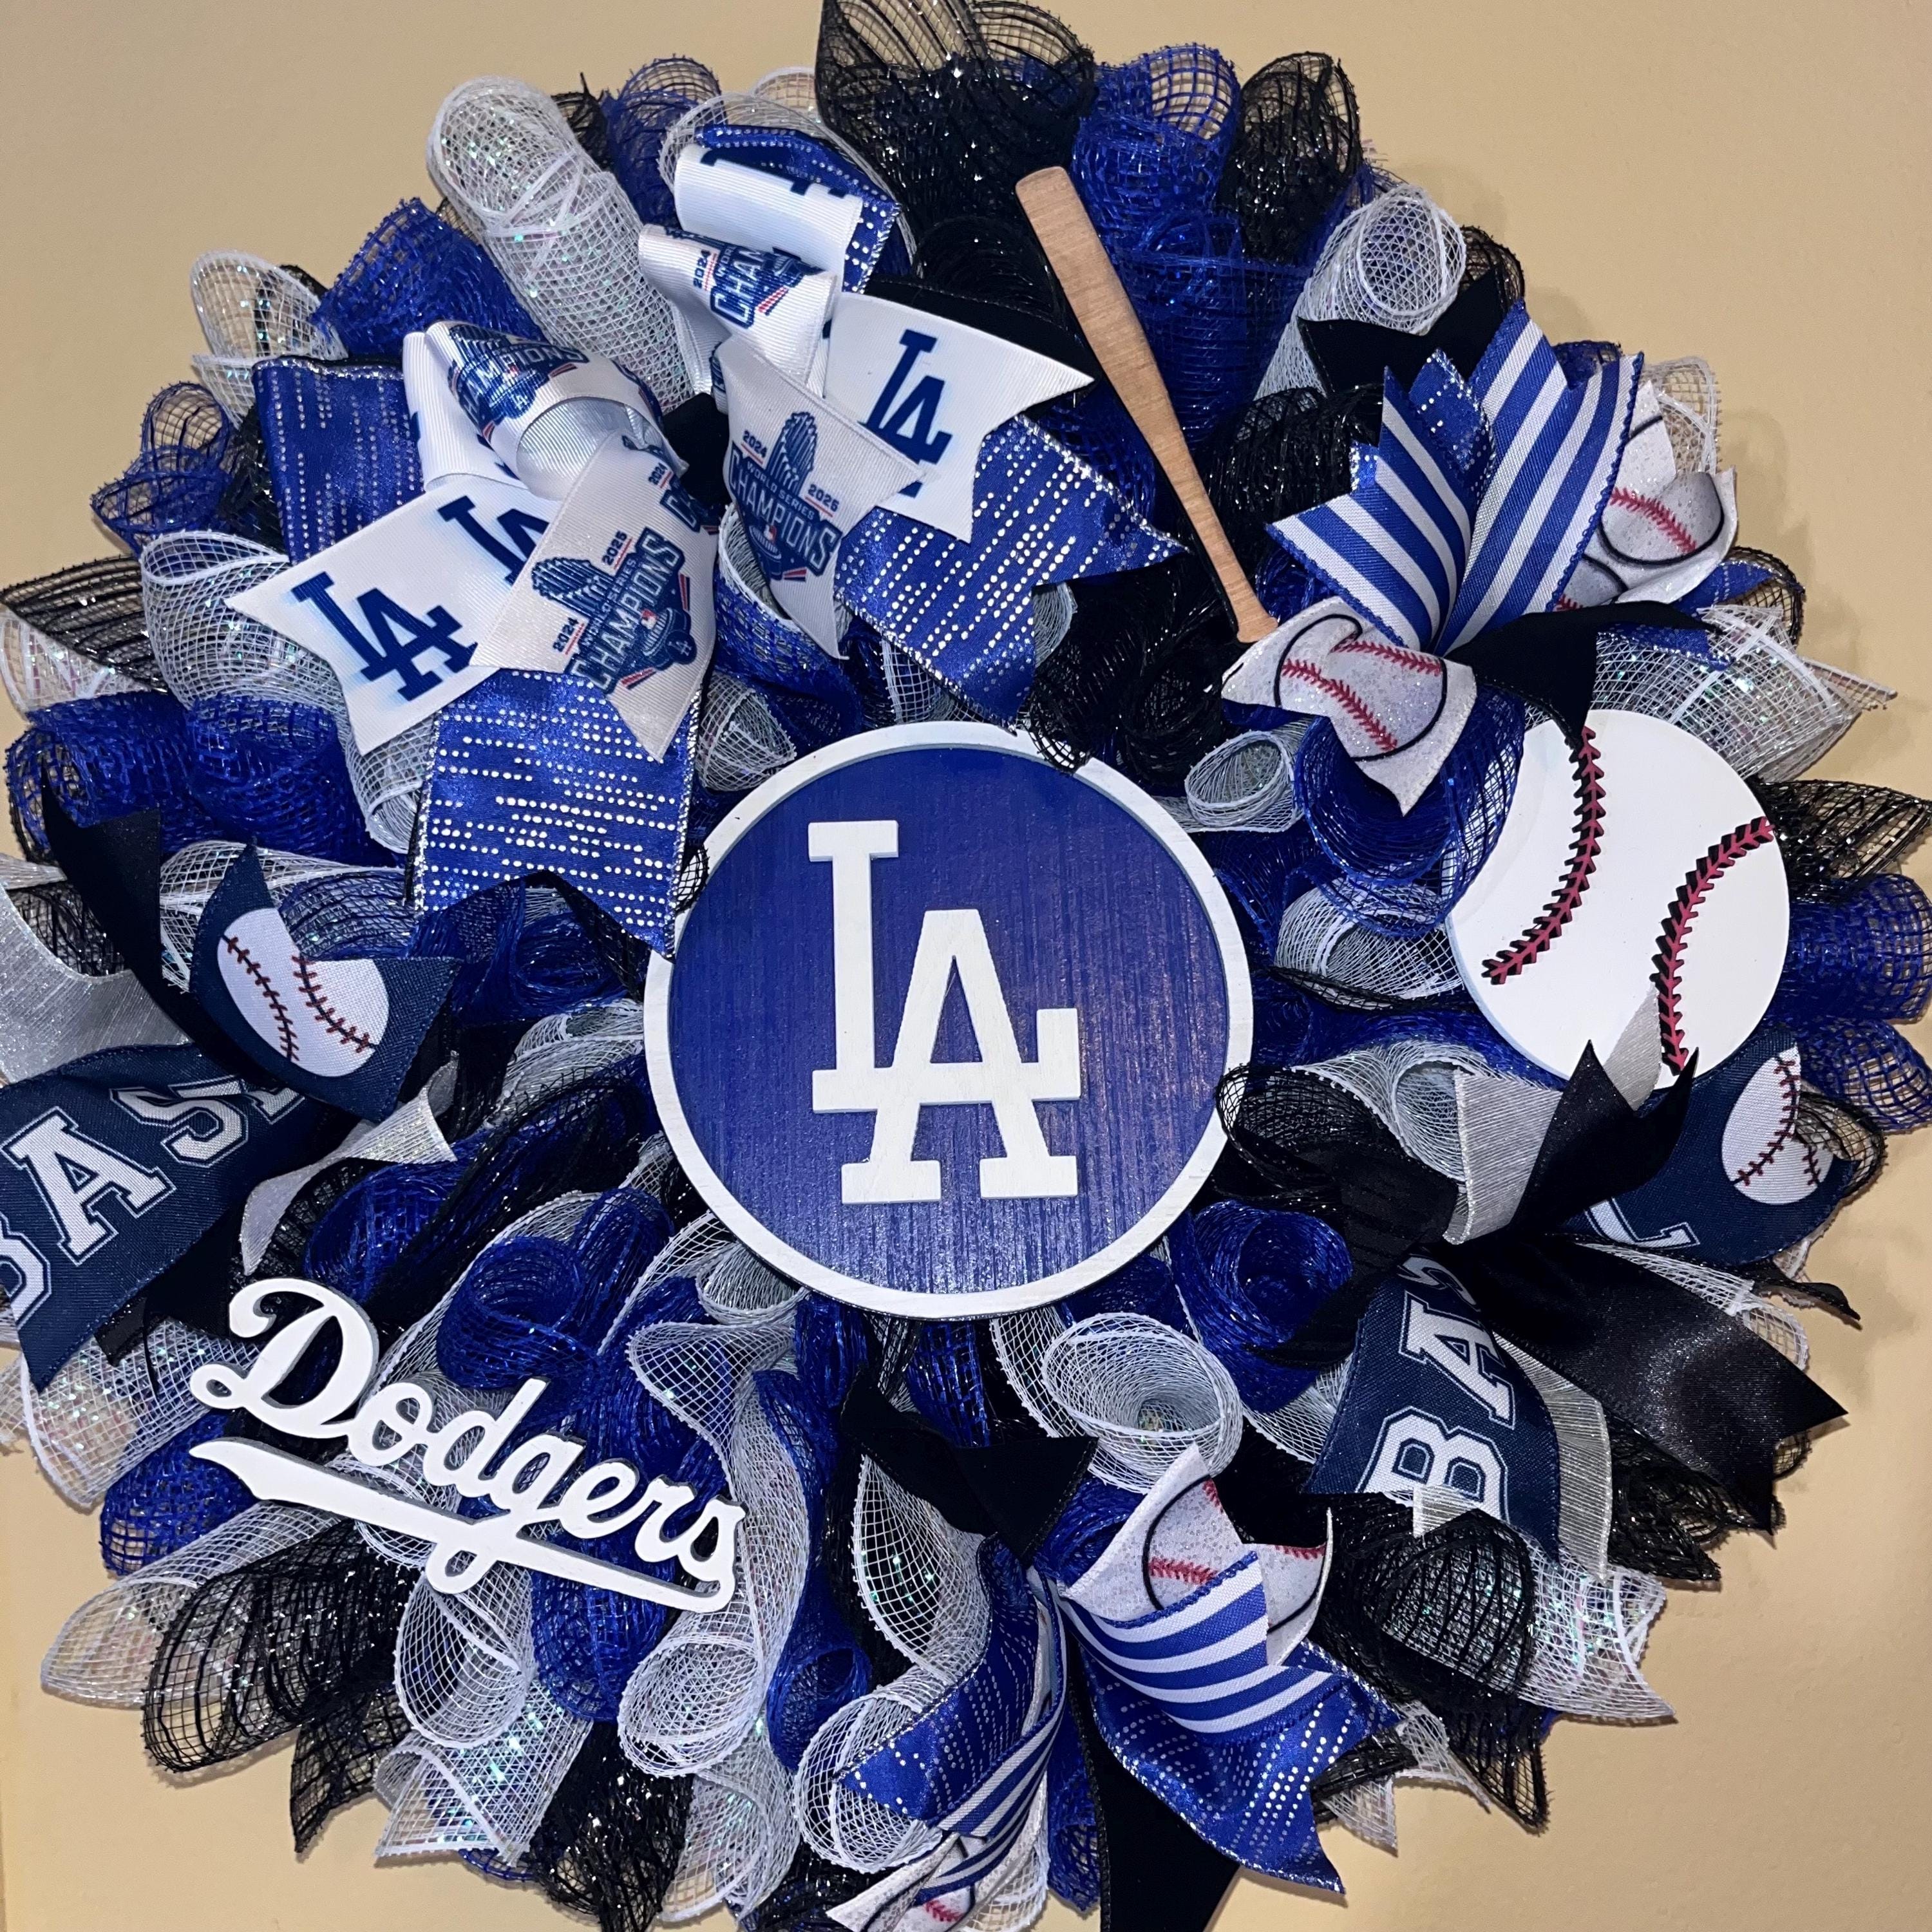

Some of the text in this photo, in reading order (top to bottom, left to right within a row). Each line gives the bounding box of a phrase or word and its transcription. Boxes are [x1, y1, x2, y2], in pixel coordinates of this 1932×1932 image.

[693, 249, 711, 289] 2024
[743, 430, 768, 459] 2024
[857, 329, 953, 499] LA
[648, 462, 668, 485] 2024
[729, 448, 838, 569] CHAMPIONS
[746, 460, 815, 521] WORLD SERIES
[571, 535, 680, 690] CHAMPIONS
[611, 559, 638, 603] SERIES
[292, 572, 477, 701] LA
[552, 617, 579, 652] 2024
[808, 820, 1081, 1205] LA
[189, 1277, 747, 1613] Dodgers
